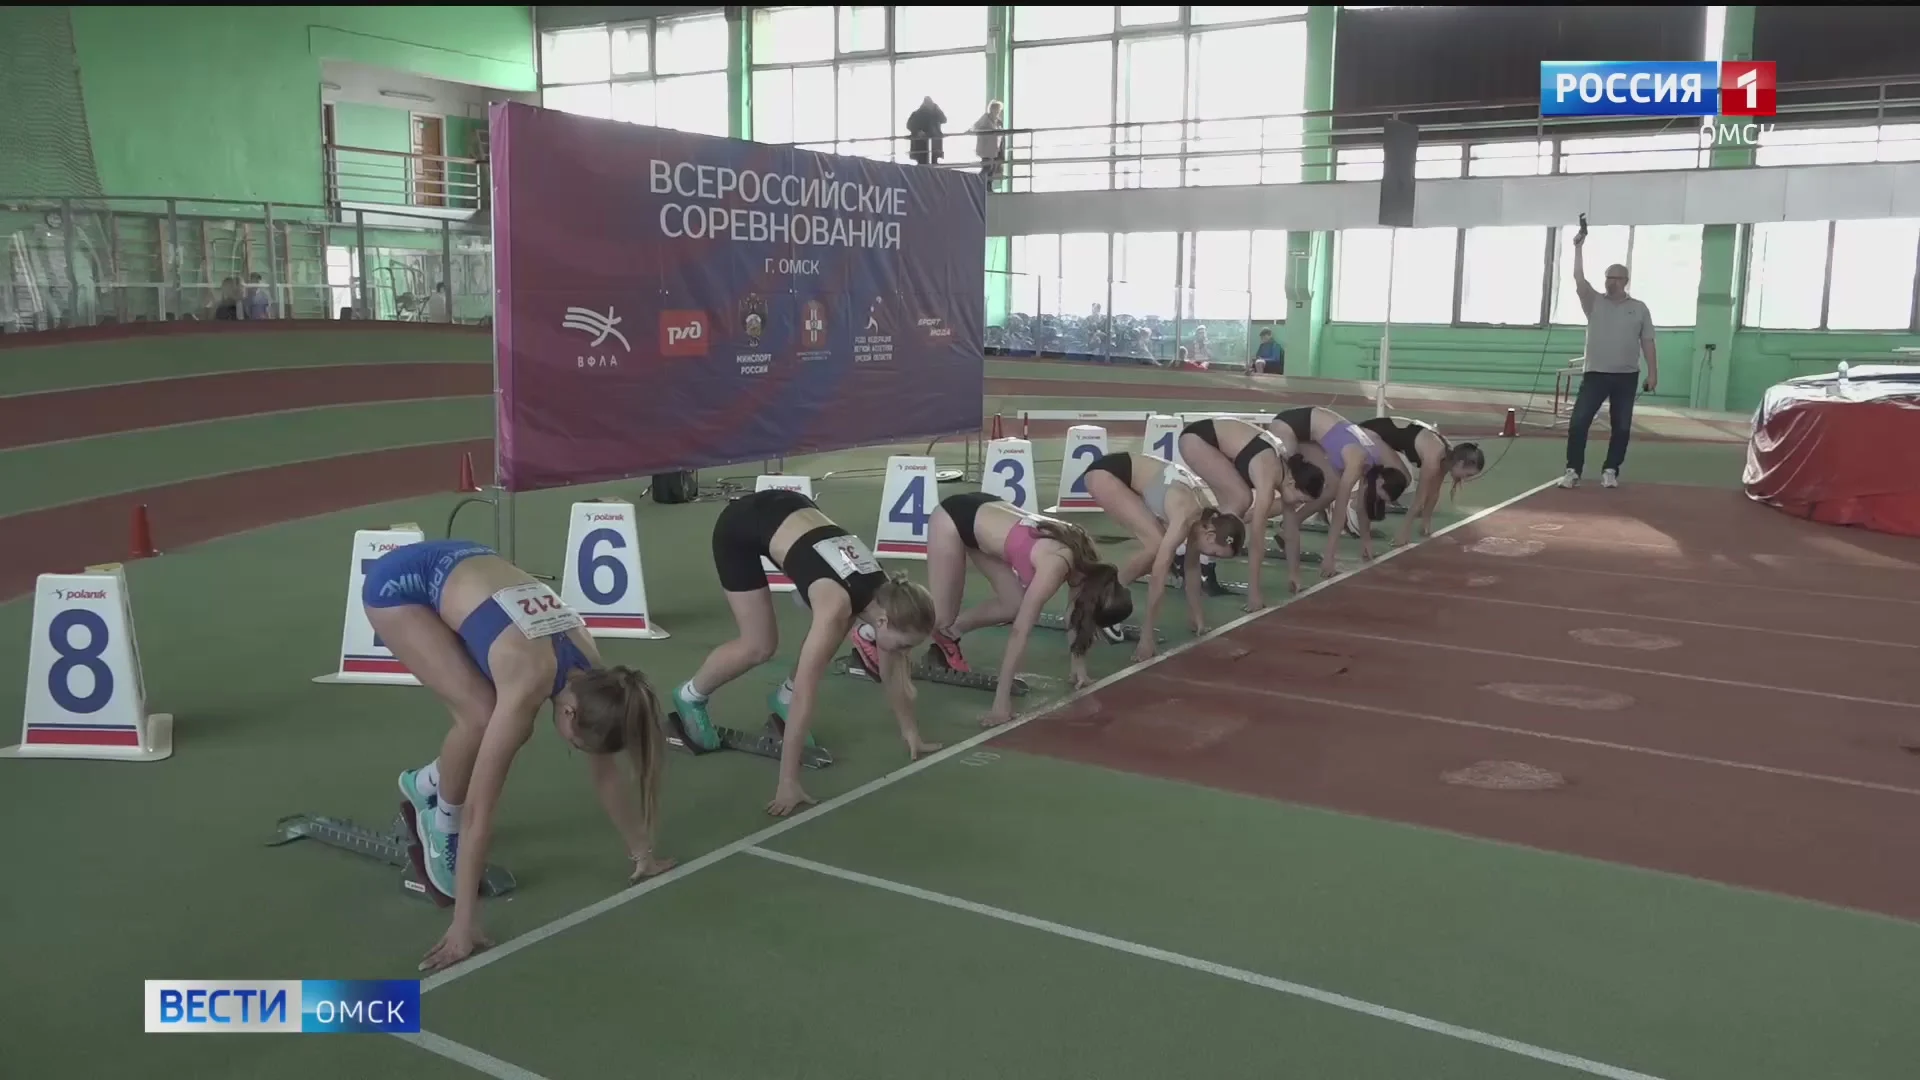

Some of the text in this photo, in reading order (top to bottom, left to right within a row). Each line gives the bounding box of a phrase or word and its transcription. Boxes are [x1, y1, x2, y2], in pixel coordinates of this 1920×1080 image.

[649, 159, 908, 217] ВСЕРОССИЙСКИЕ
[659, 203, 901, 251] СОРЕВНОВАНИЯ
[778, 258, 820, 276] ОМСК
[577, 355, 618, 369] ВФЛА
[736, 353, 772, 364] МИНСПОРТ
[740, 364, 768, 375] РОССИИ
[1153, 431, 1174, 462] 1
[993, 458, 1027, 508] 3
[1070, 443, 1105, 493] 2
[888, 475, 931, 537] 4
[578, 528, 629, 605] 6
[66, 588, 108, 601] polanik
[517, 594, 562, 616] 212
[48, 608, 114, 714] 8
